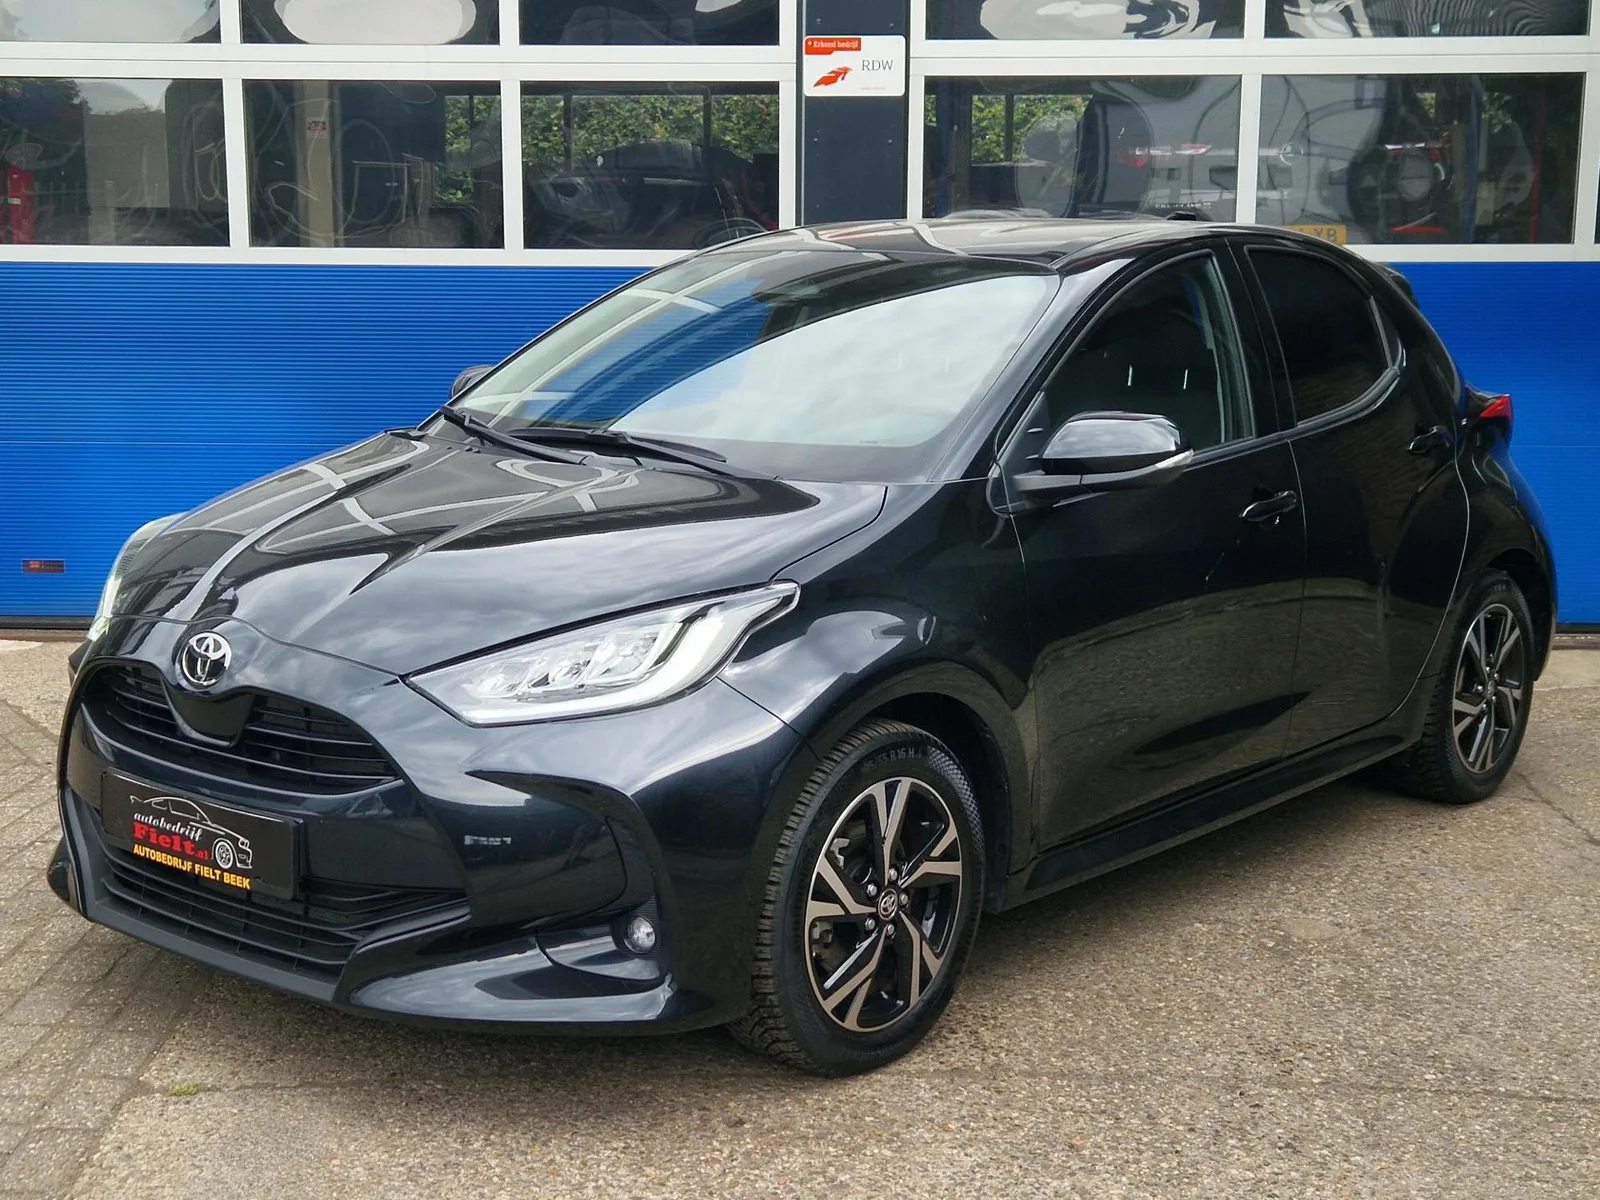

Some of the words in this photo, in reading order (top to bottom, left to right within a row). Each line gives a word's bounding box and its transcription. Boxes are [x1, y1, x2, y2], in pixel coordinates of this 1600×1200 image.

[837, 41, 858, 49] bedrijf
[861, 59, 893, 71] RDW
[133, 811, 203, 842] autobedrijf
[133, 843, 193, 872] AUTOBEDRIJF
[194, 863, 223, 882] FIELT
[223, 871, 251, 890] BEEK
